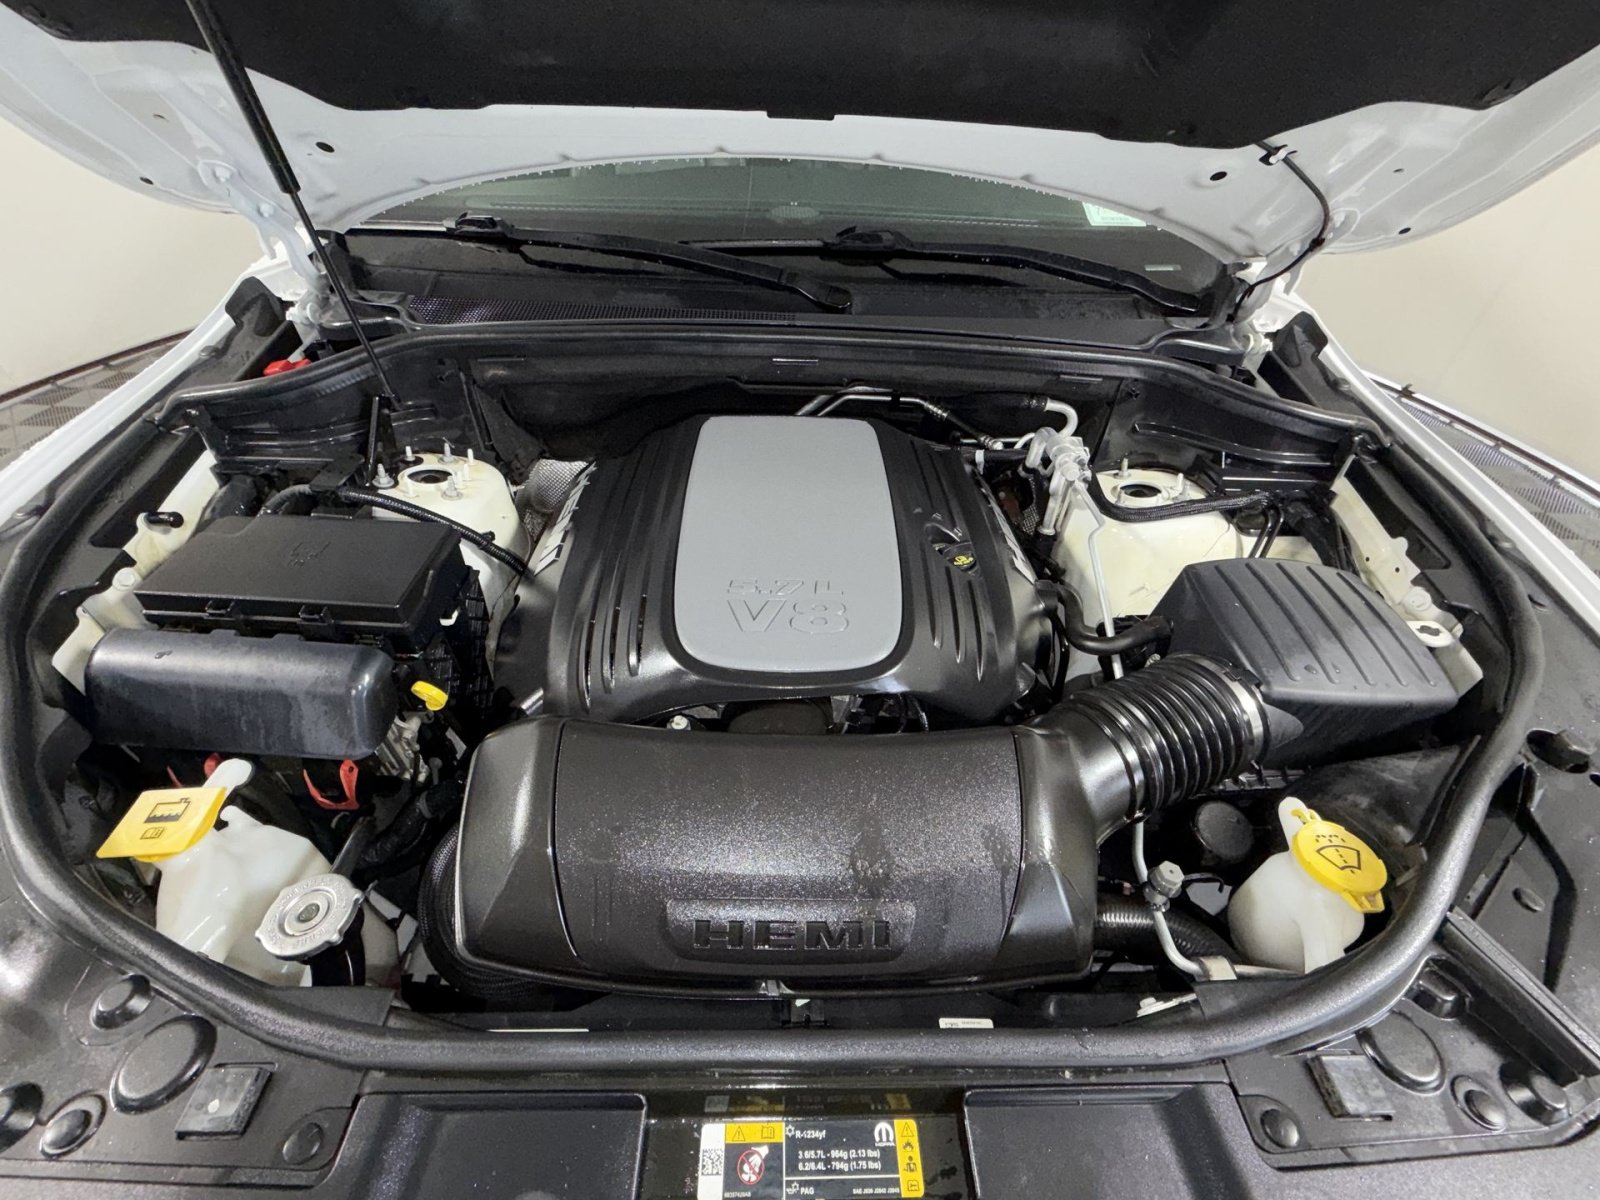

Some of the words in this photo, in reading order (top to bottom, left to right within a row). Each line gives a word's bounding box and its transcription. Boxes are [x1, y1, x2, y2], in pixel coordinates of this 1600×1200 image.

[726, 598, 849, 634] V8
[693, 919, 892, 951] HEMI
[795, 1129, 826, 1140] R-1234yf
[798, 1150, 826, 1159] 3.6/5.7L
[849, 1149, 866, 1160] (2.13
[867, 1148, 881, 1159] lbs)
[798, 1161, 827, 1171] 6.2/6.4L
[831, 1161, 849, 1172] 794g
[850, 1161, 867, 1172] (1.75
[868, 1160, 882, 1171] lbs)
[800, 1187, 815, 1195] PAG
